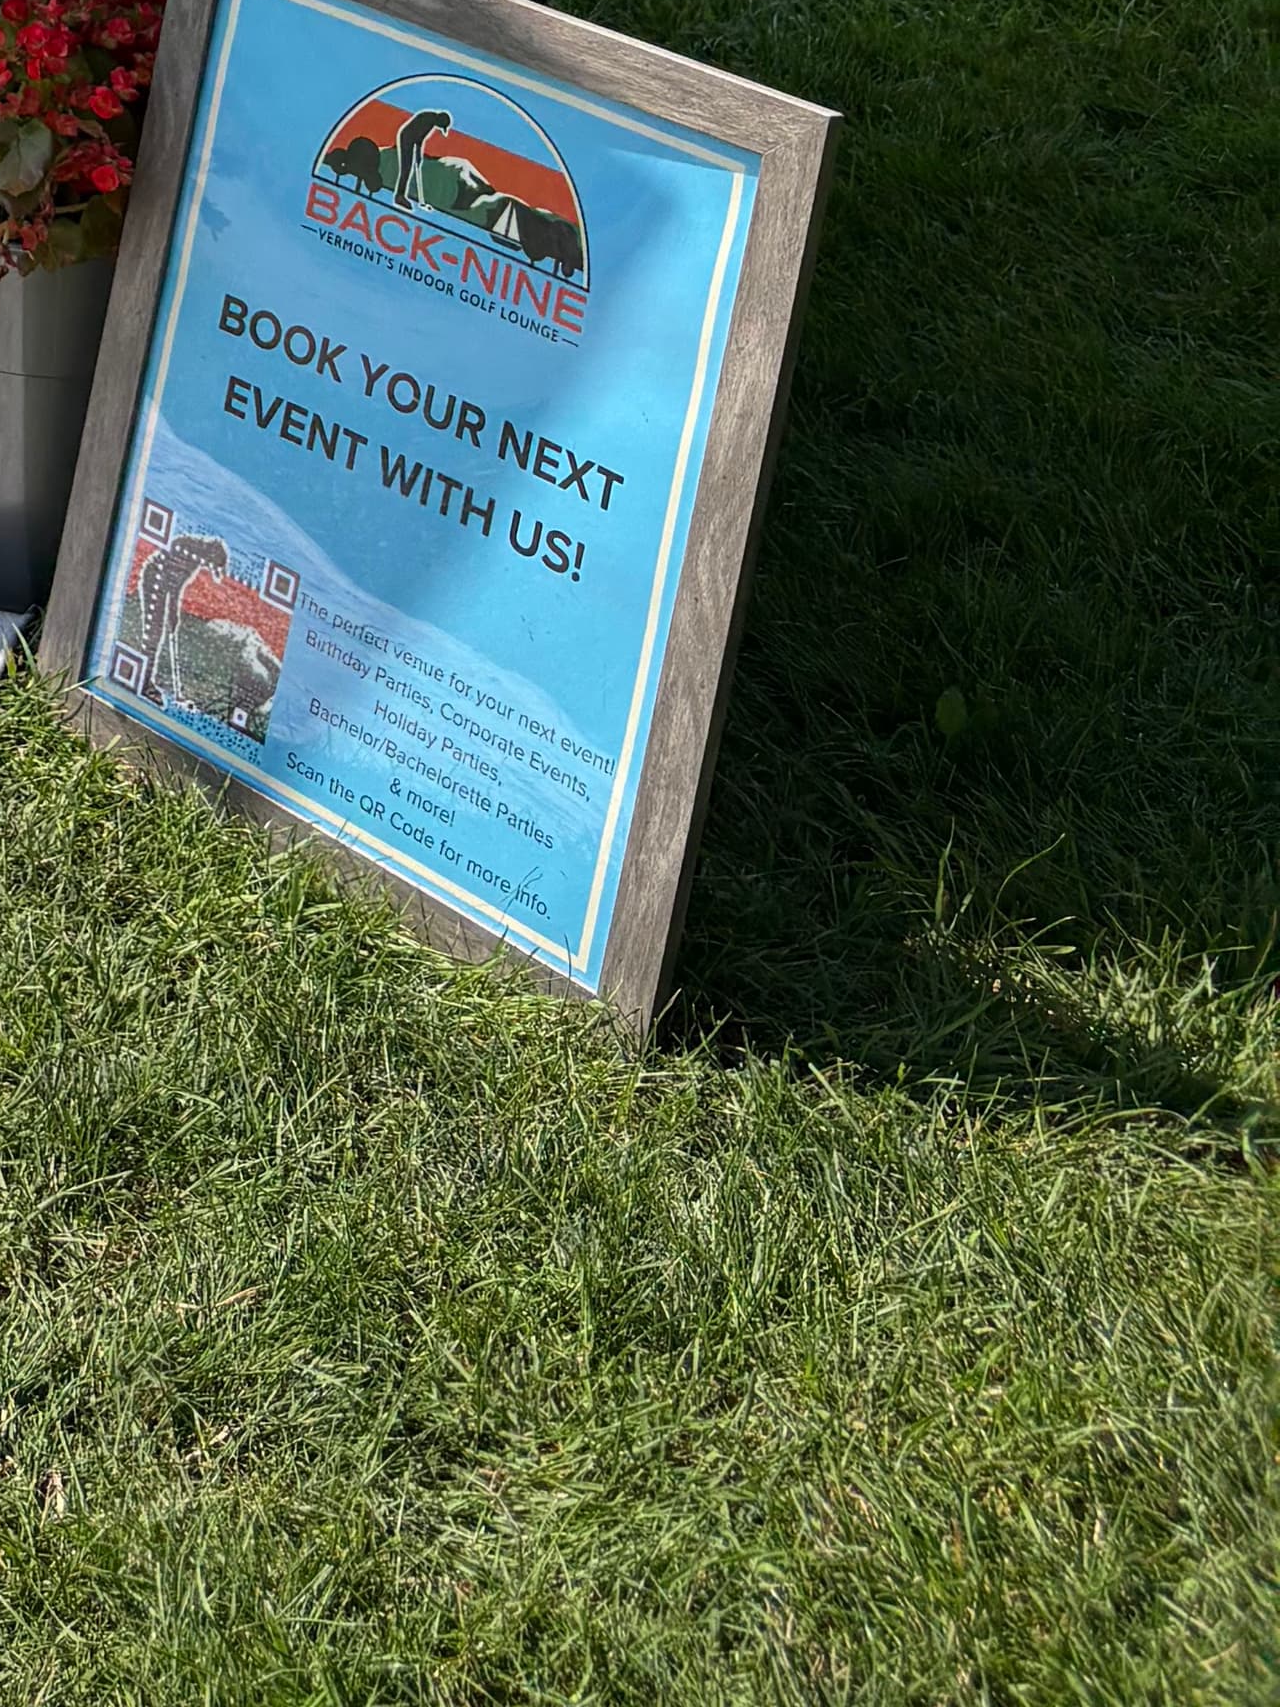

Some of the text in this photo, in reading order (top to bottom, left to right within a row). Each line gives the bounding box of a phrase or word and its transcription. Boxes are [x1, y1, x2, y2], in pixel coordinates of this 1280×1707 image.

[305, 183, 588, 334] BACK-NINE
[318, 227, 559, 342] VERMONT'S INDOOR GOLF LOUNGE
[218, 294, 625, 511] BOOK YOUR NEXT
[223, 376, 586, 583] EVENT WITH US!
[300, 592, 617, 777] The perfect venue for your next event!
[306, 630, 591, 802] Birthday Parties, Corporate Events,
[373, 700, 502, 786] Holiday Parties,
[286, 752, 325, 786] Scan
[329, 777, 355, 803] the
[359, 795, 386, 821] QR
[390, 812, 435, 849] Code
[439, 839, 463, 866] for
[466, 858, 511, 893] more
[309, 698, 555, 849] Bachelor/Bachelorette Parties
[389, 777, 456, 827] & more!
